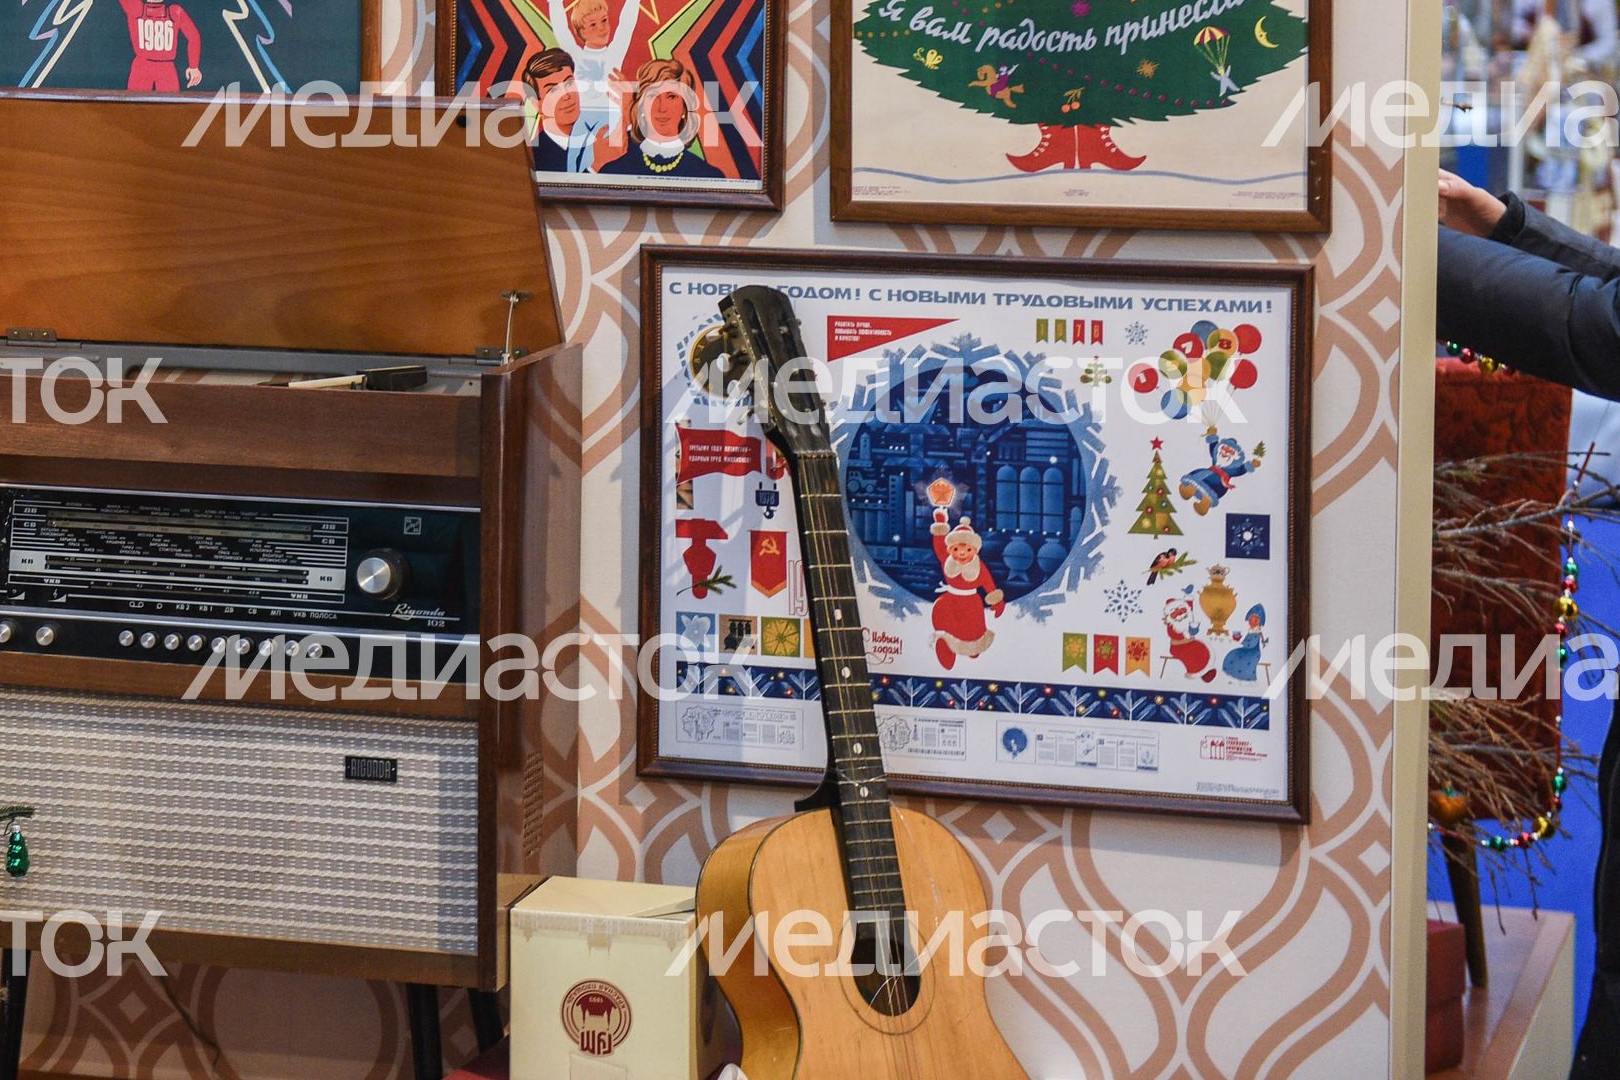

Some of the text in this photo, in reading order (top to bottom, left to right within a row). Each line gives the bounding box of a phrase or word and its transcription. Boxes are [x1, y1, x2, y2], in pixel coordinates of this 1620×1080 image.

[137, 18, 174, 51] 1986
[909, 4, 972, 45] вам
[975, 19, 1097, 53] радость
[669, 281, 682, 295] С
[869, 288, 882, 302] С
[888, 289, 986, 305] НОВЫМИ
[993, 293, 1133, 310] ТРУДОВЫМИ
[1141, 298, 1272, 313] УСПЕХАМИ!
[427, 619, 445, 627] 102
[351, 758, 391, 779] RIGONDA
[580, 1029, 612, 1055] ГУМ
